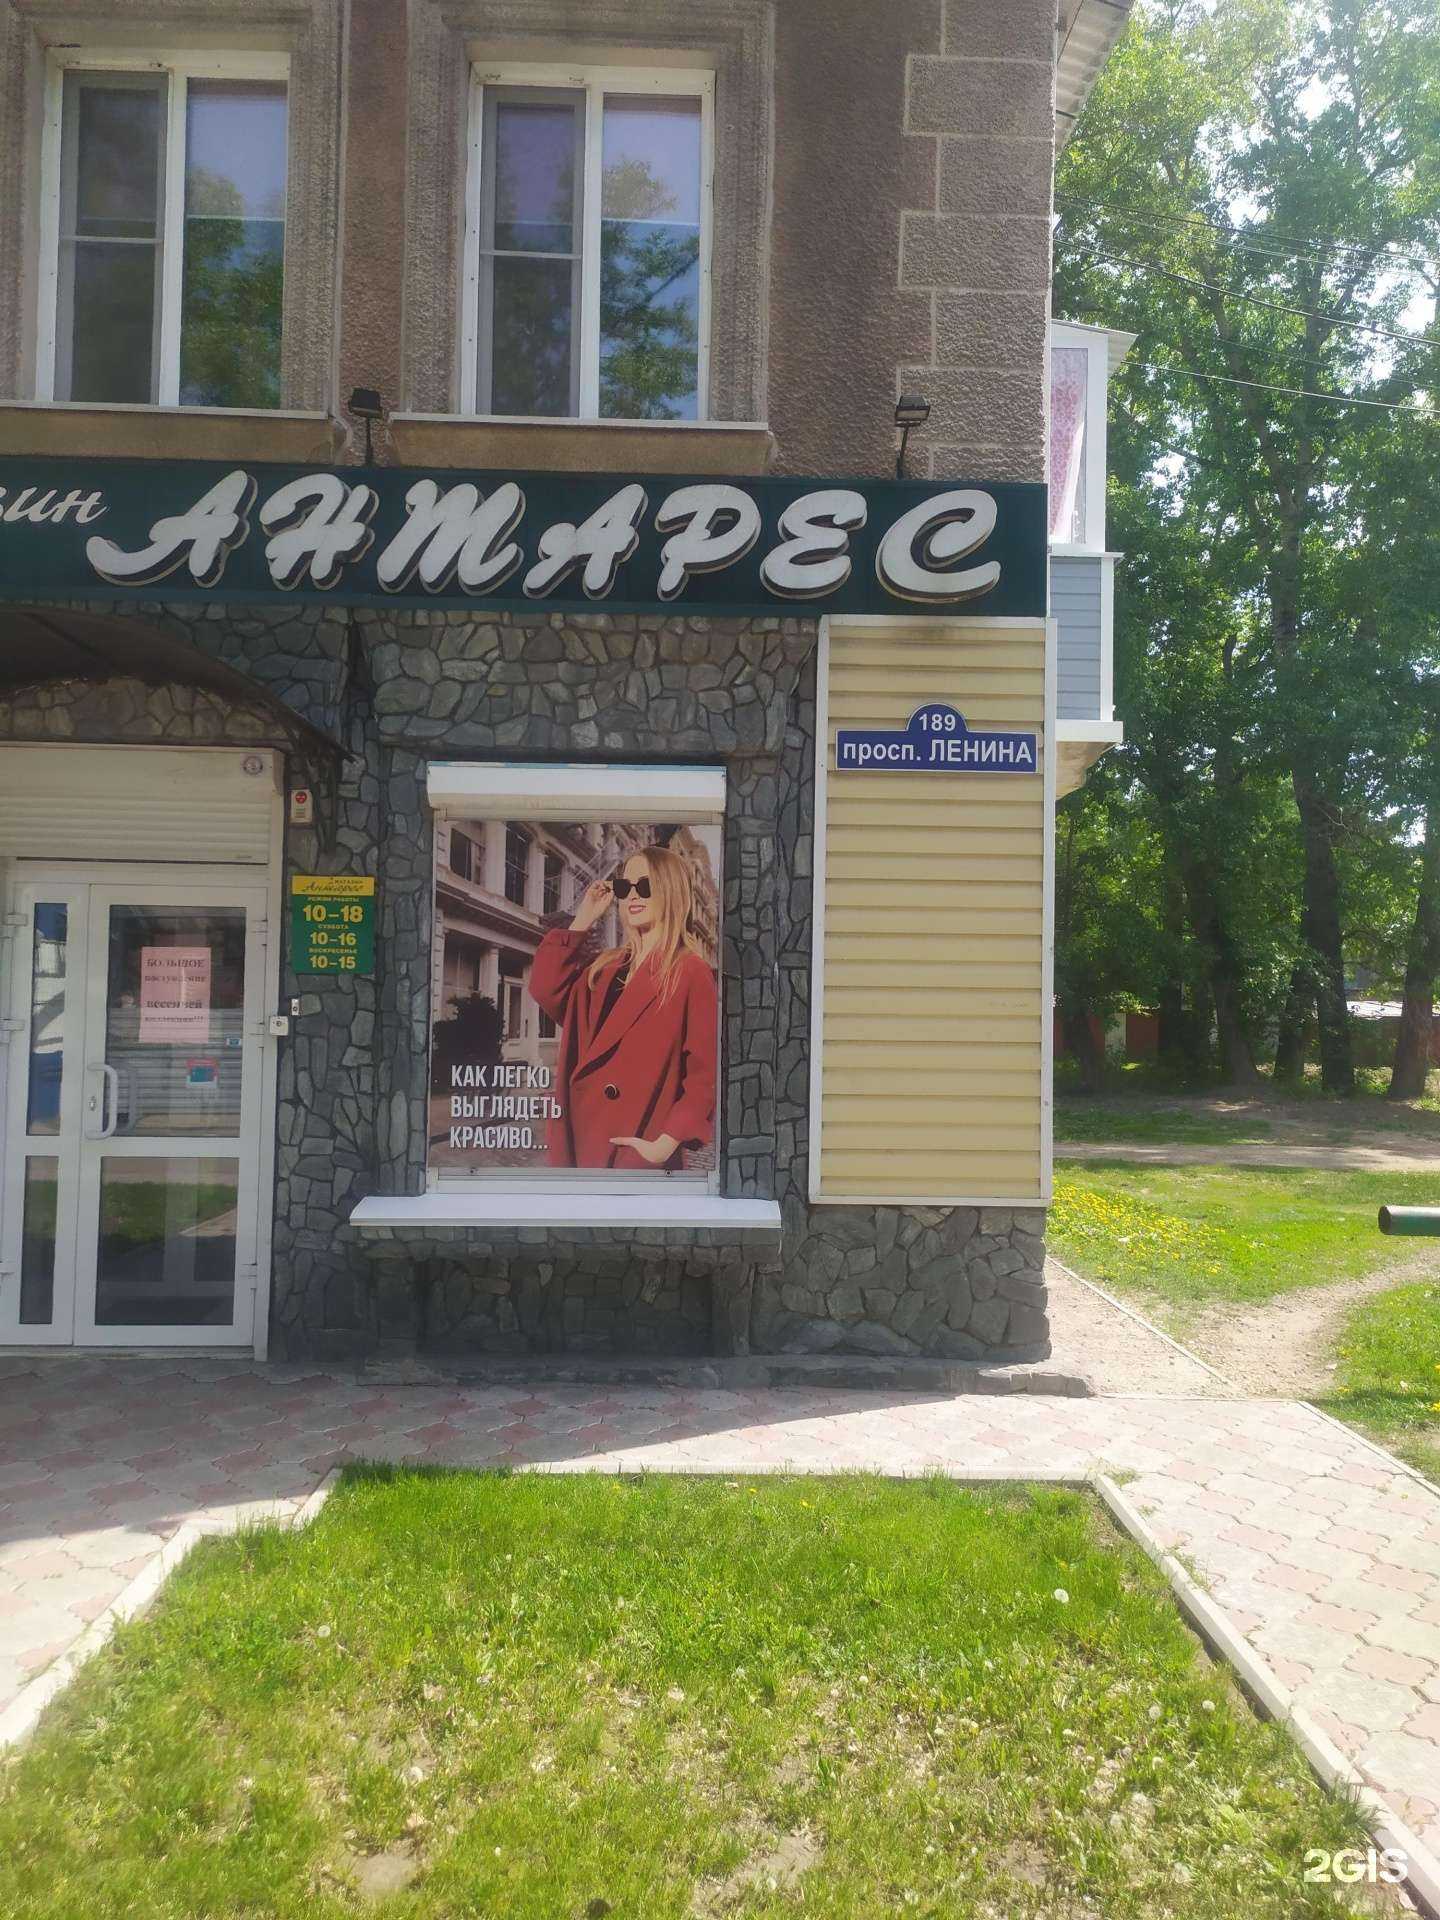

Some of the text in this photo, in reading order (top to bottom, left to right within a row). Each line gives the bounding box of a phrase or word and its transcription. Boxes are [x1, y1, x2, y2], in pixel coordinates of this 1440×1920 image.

[918, 713, 956, 732] 189
[843, 739, 1033, 765] просп. ЛЕНИНА
[451, 1065, 550, 1088] КАК ЛЕГКО
[450, 1096, 562, 1120] ВЫГЛЯДЕТЬ
[449, 1126, 549, 1149] КРАСИВО...
